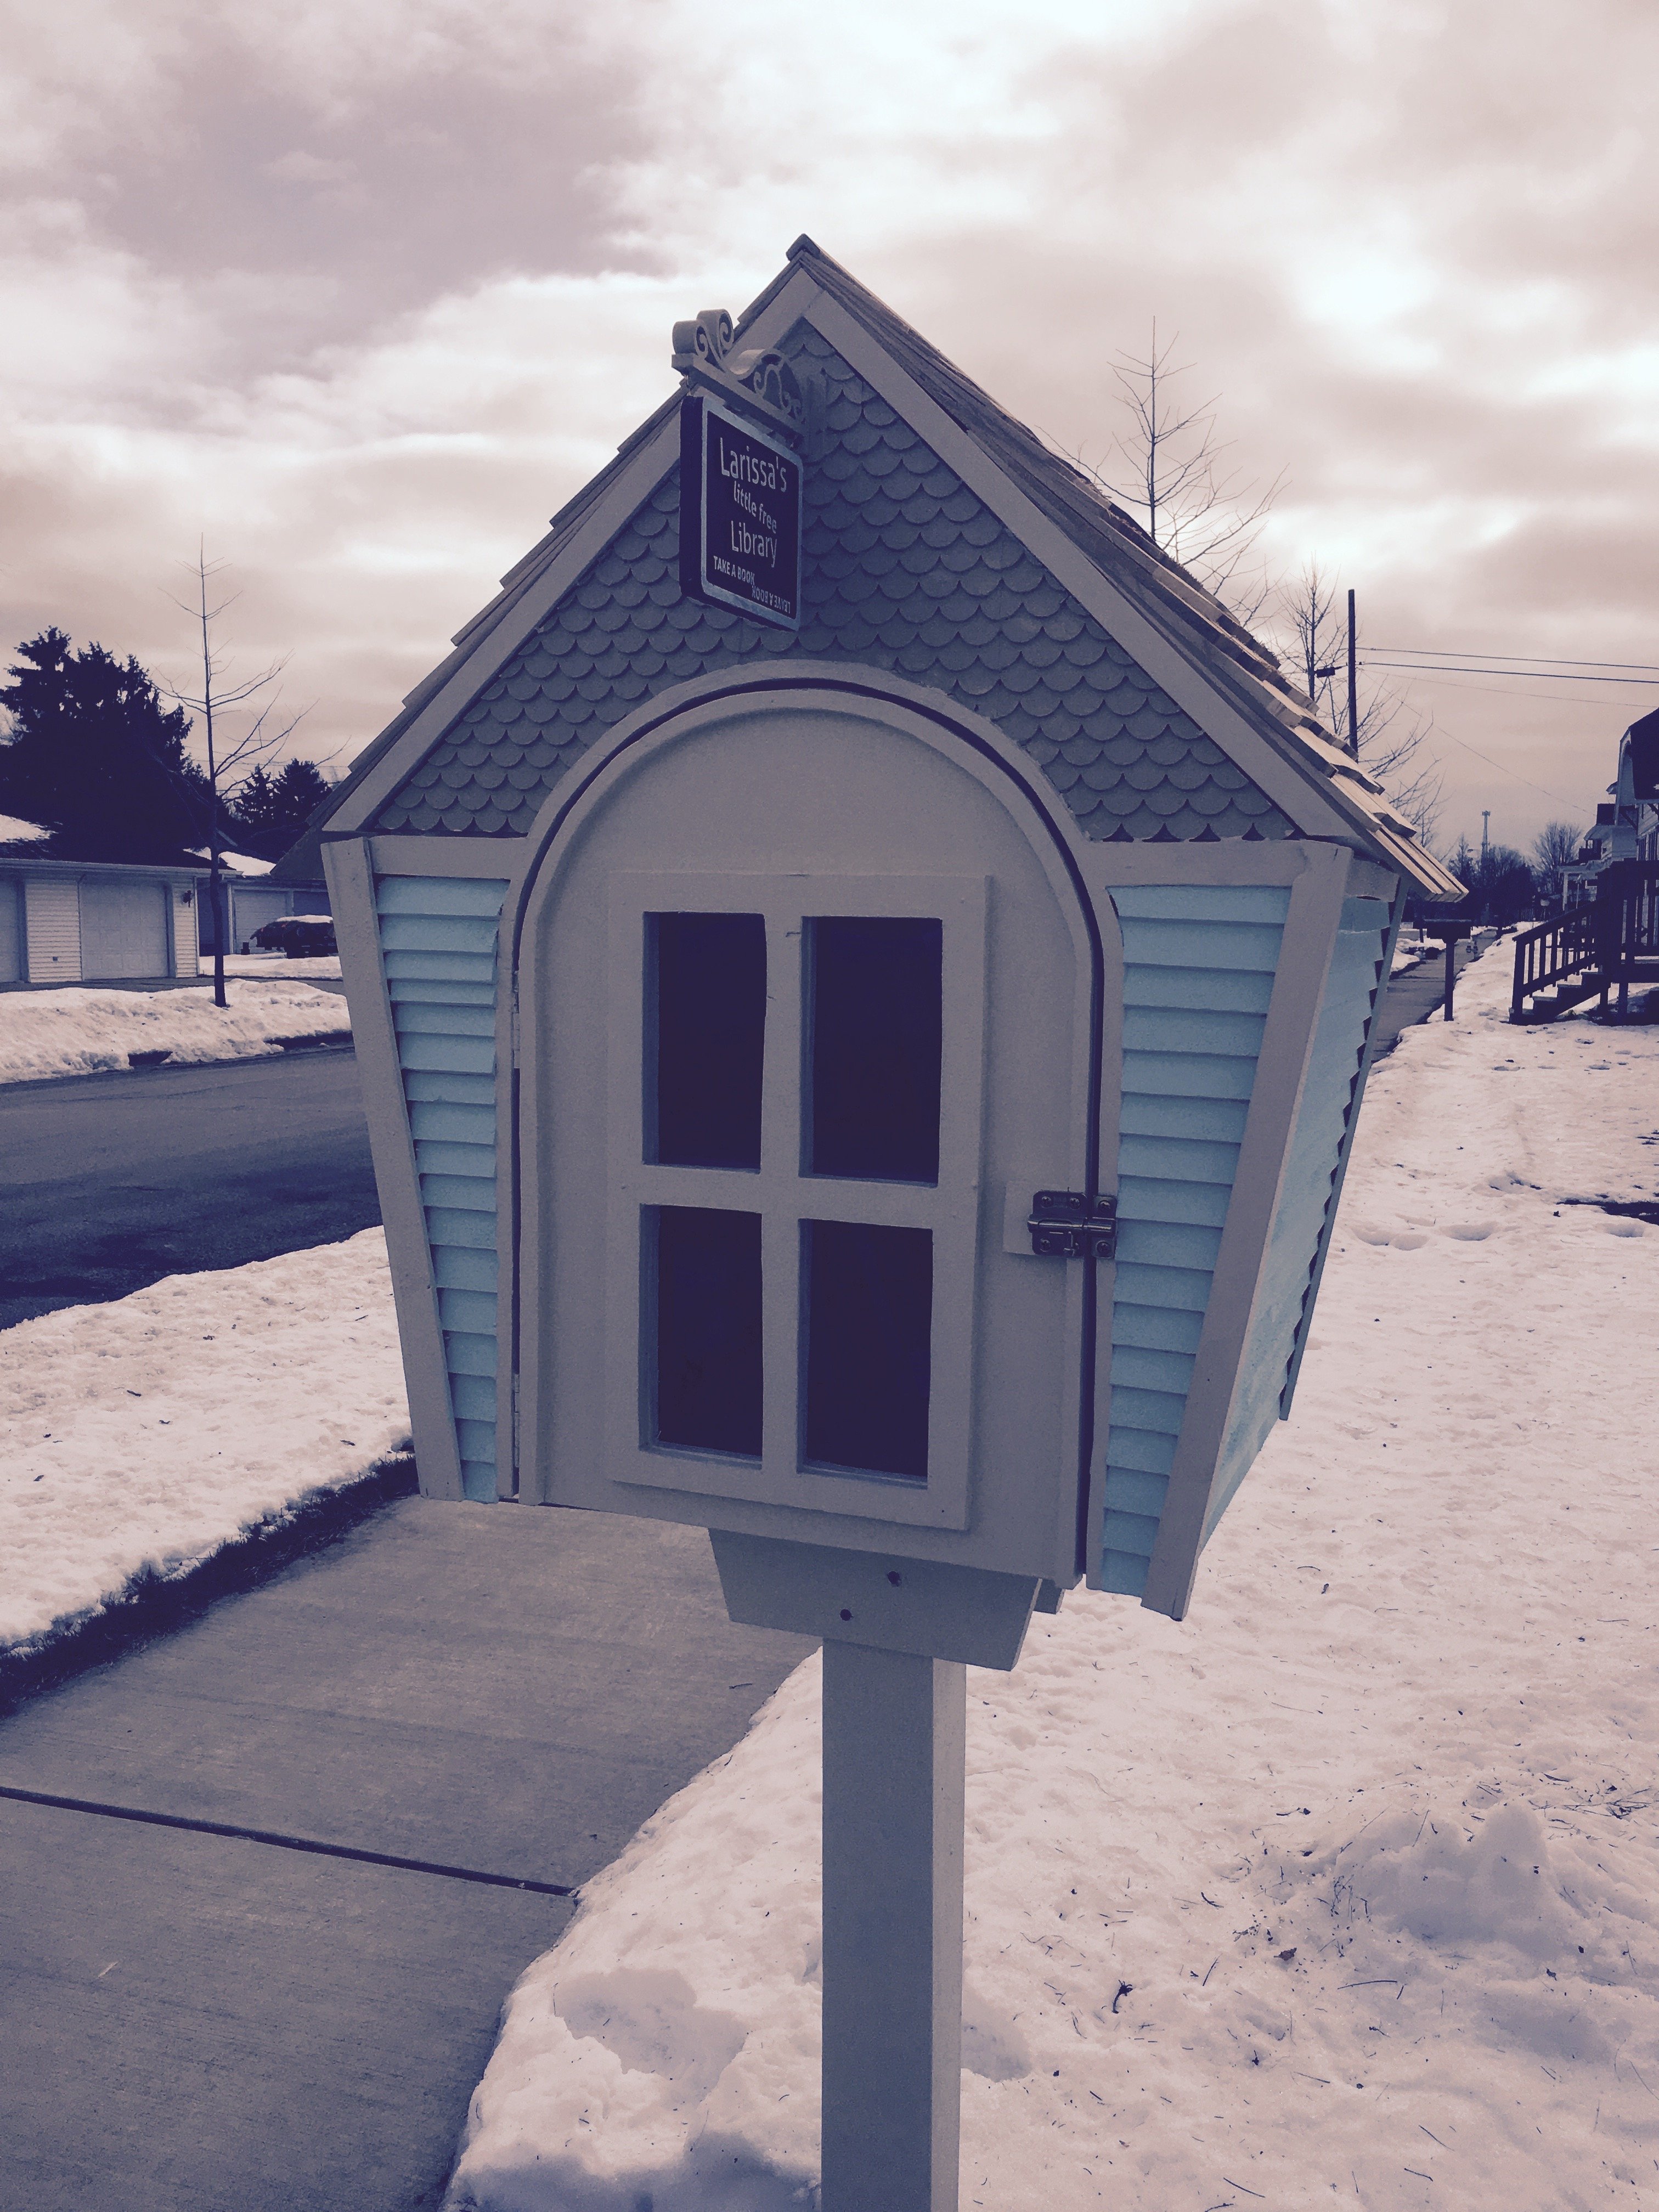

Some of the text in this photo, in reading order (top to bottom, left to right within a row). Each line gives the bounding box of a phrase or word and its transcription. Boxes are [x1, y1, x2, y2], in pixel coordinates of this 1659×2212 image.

[719, 437, 787, 493] Larissa's
[733, 481, 777, 534] little free
[731, 520, 777, 568] Library
[713, 555, 755, 585] TAKE A BOOK
[752, 585, 791, 614] LEAVE A BOOK
